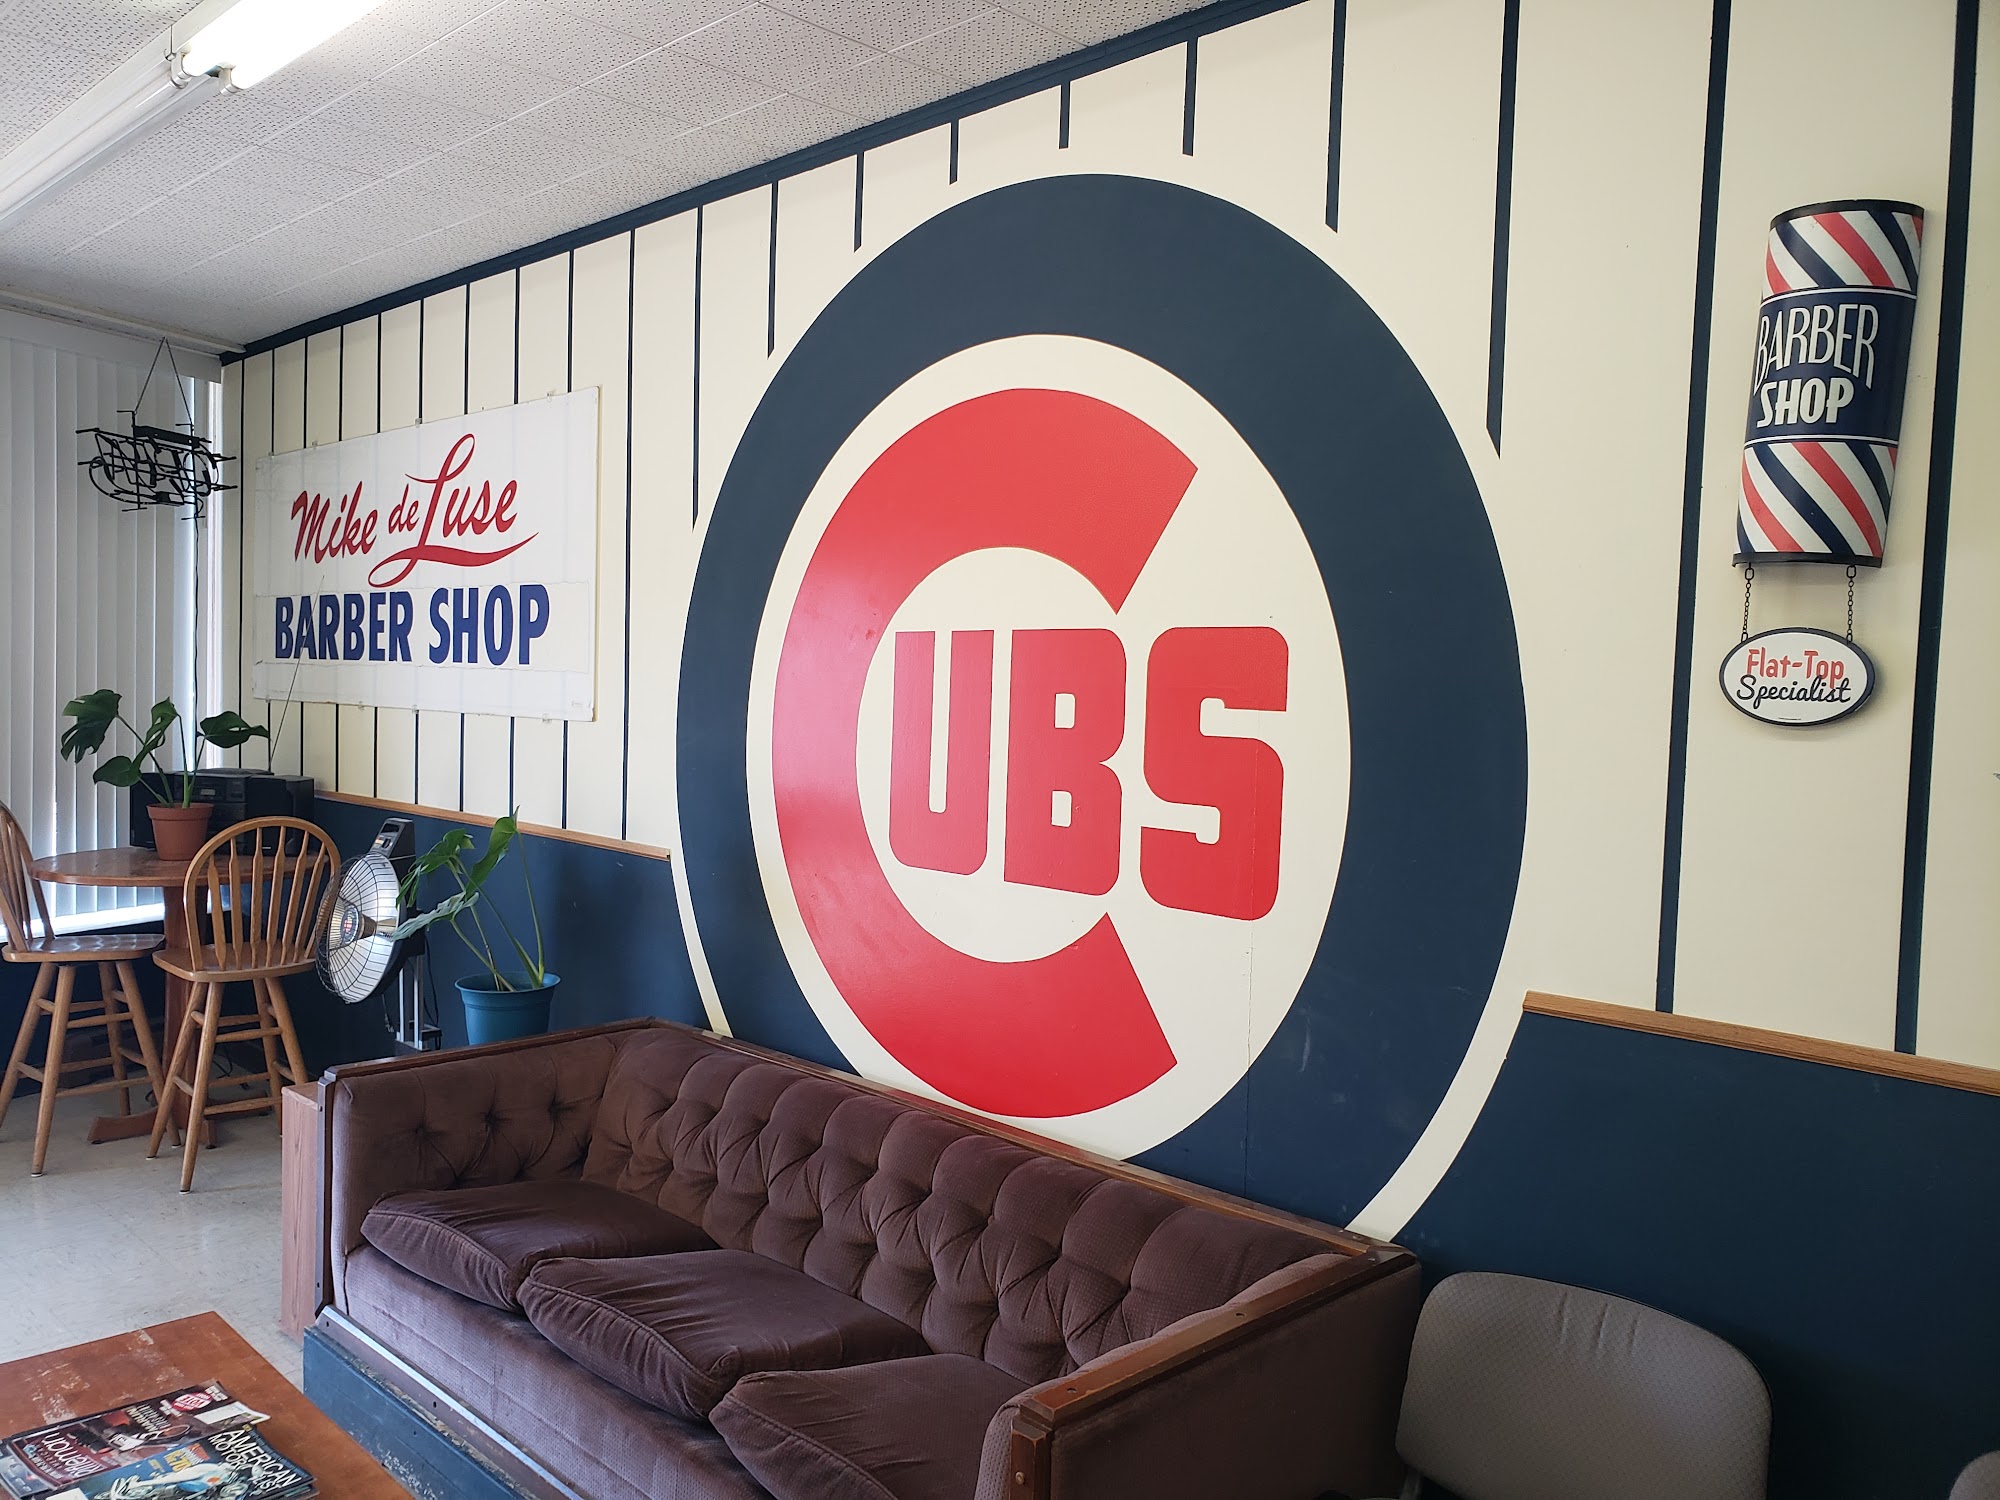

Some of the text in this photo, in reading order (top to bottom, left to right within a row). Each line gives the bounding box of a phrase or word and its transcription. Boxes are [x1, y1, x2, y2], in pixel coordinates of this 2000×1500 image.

[1753, 303, 1879, 397] BARBER
[1756, 376, 1855, 429] SHOP
[290, 433, 540, 588] Mike de Luse
[275, 584, 550, 666] BARBER SHOP
[1736, 674, 1852, 709] Specialist
[1746, 646, 1845, 689] Flat-Top
[41, 1431, 103, 1477] Rifleman
[222, 1429, 302, 1487] AMERICAN
